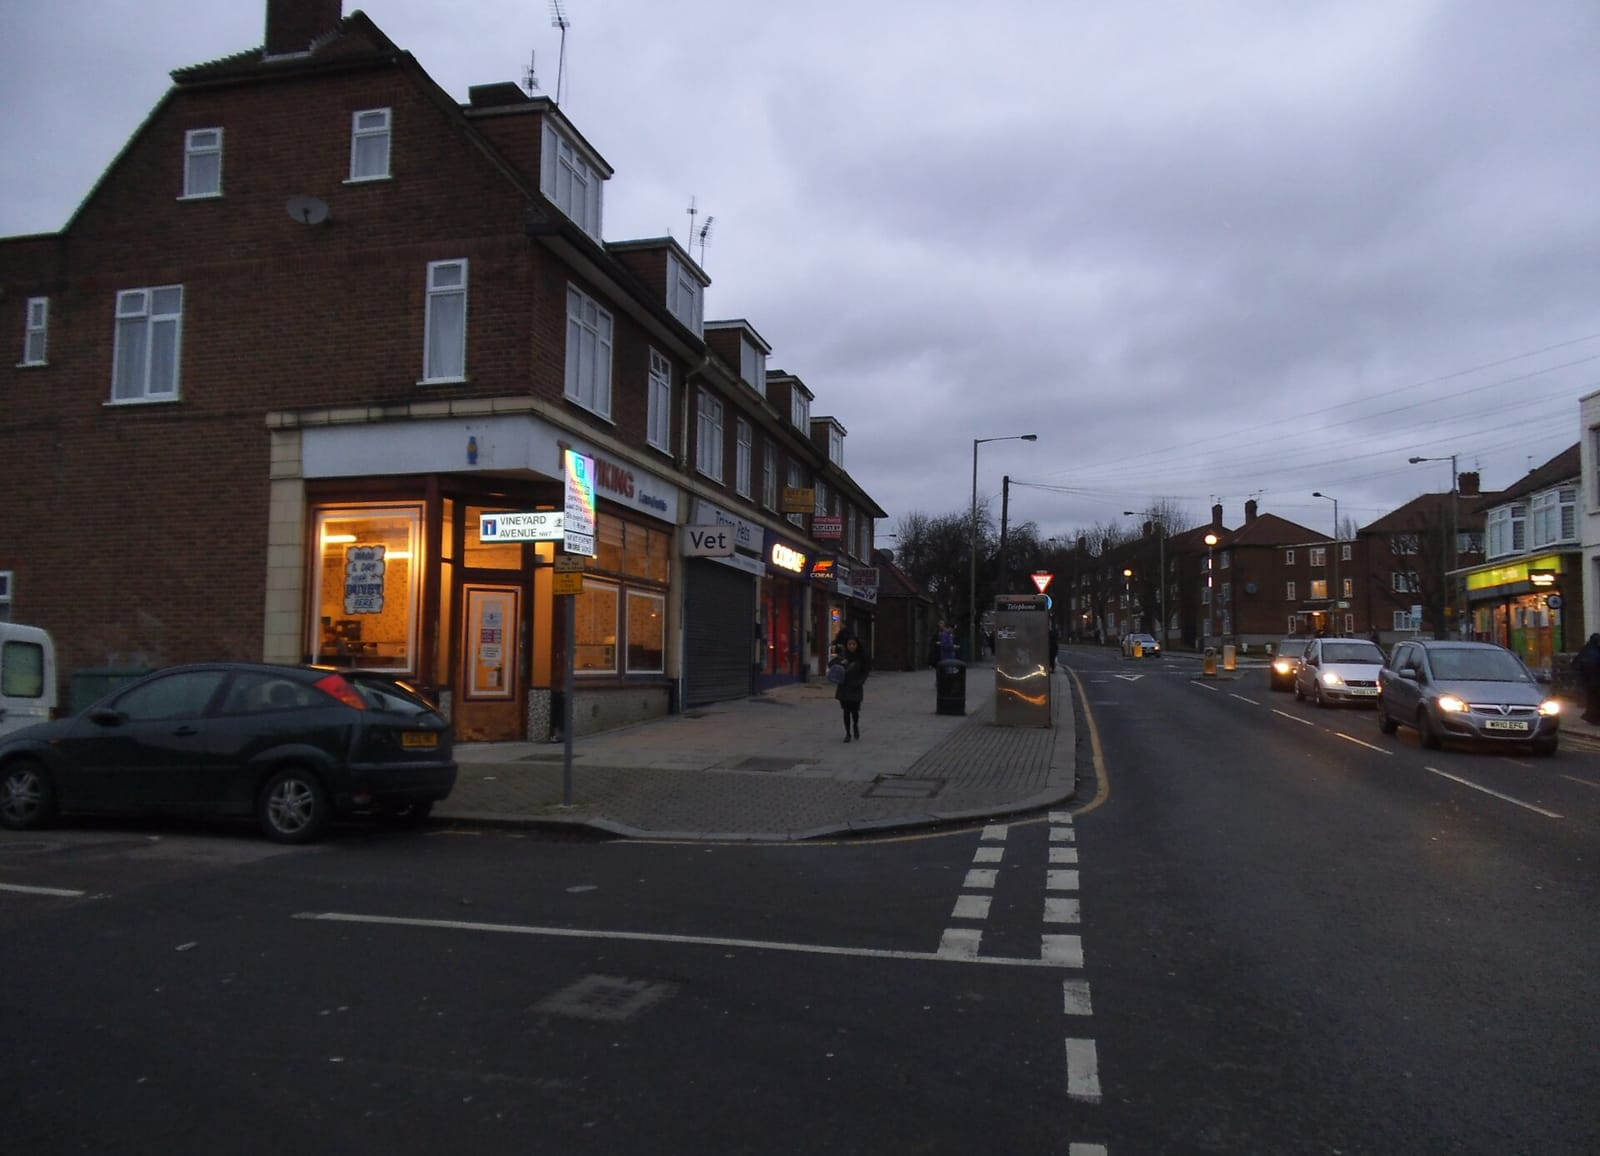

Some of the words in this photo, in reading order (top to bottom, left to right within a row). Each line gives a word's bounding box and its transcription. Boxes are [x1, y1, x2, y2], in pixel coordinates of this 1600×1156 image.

[500, 515, 547, 526] VINEYARD
[499, 528, 537, 538] AVENUE
[690, 531, 727, 550] Vet
